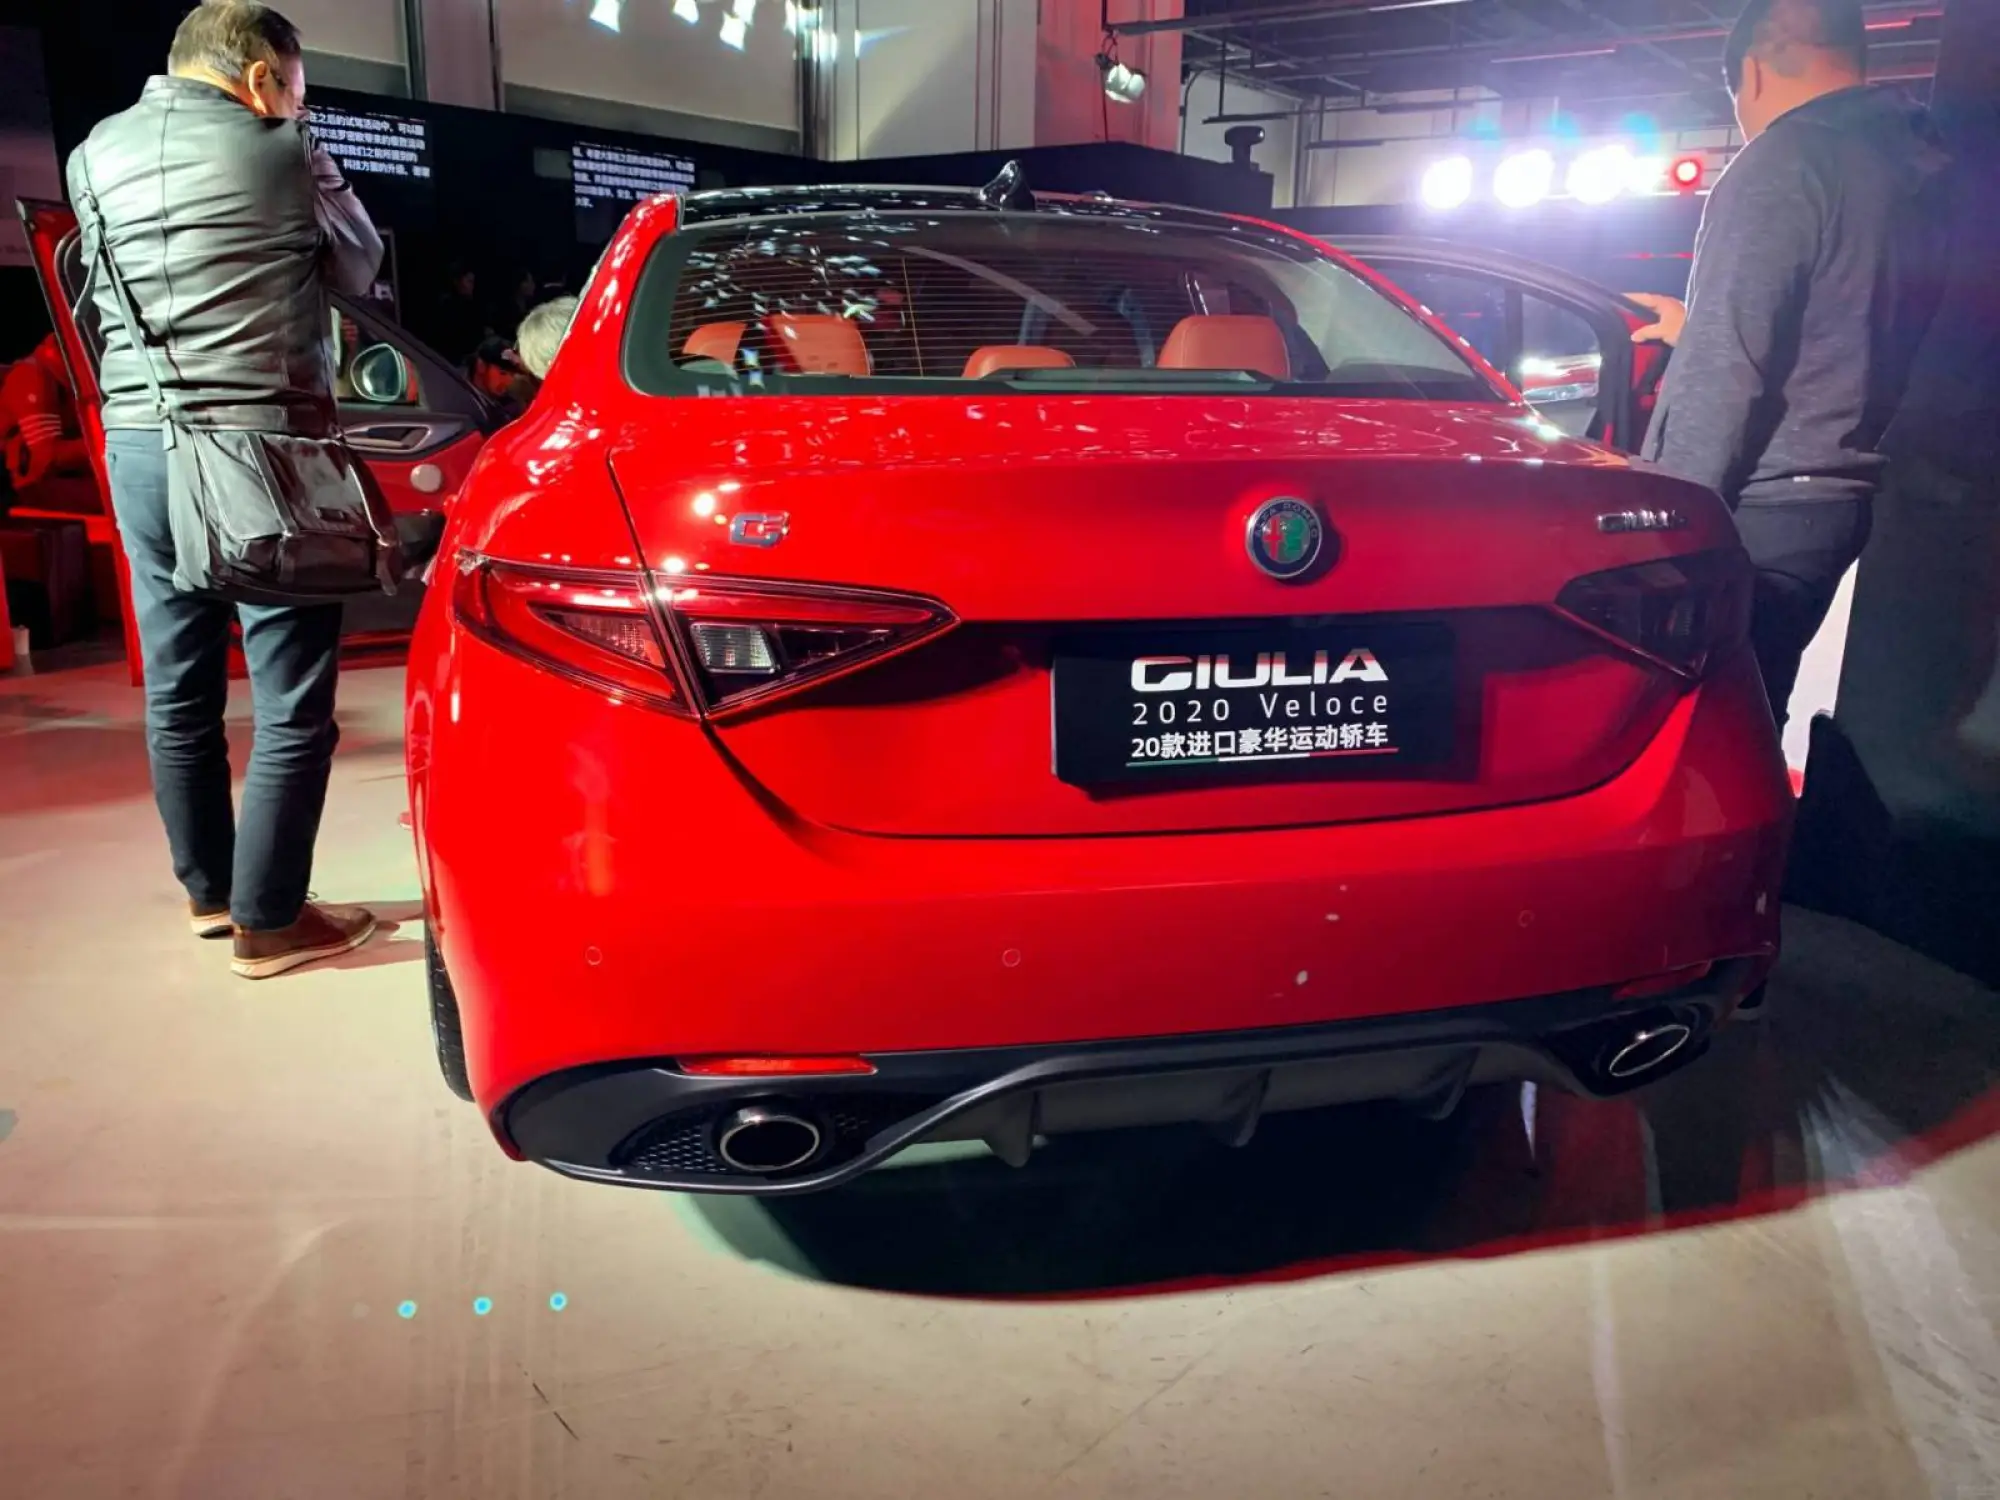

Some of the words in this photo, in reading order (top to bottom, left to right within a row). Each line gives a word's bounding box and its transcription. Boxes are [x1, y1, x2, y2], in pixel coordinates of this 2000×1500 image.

[1130, 648, 1389, 692] GIULIA
[1132, 699, 1230, 726] 2020
[1259, 691, 1388, 719] Veloce
[1131, 722, 1389, 759] 20款进口豪华运动轿车
